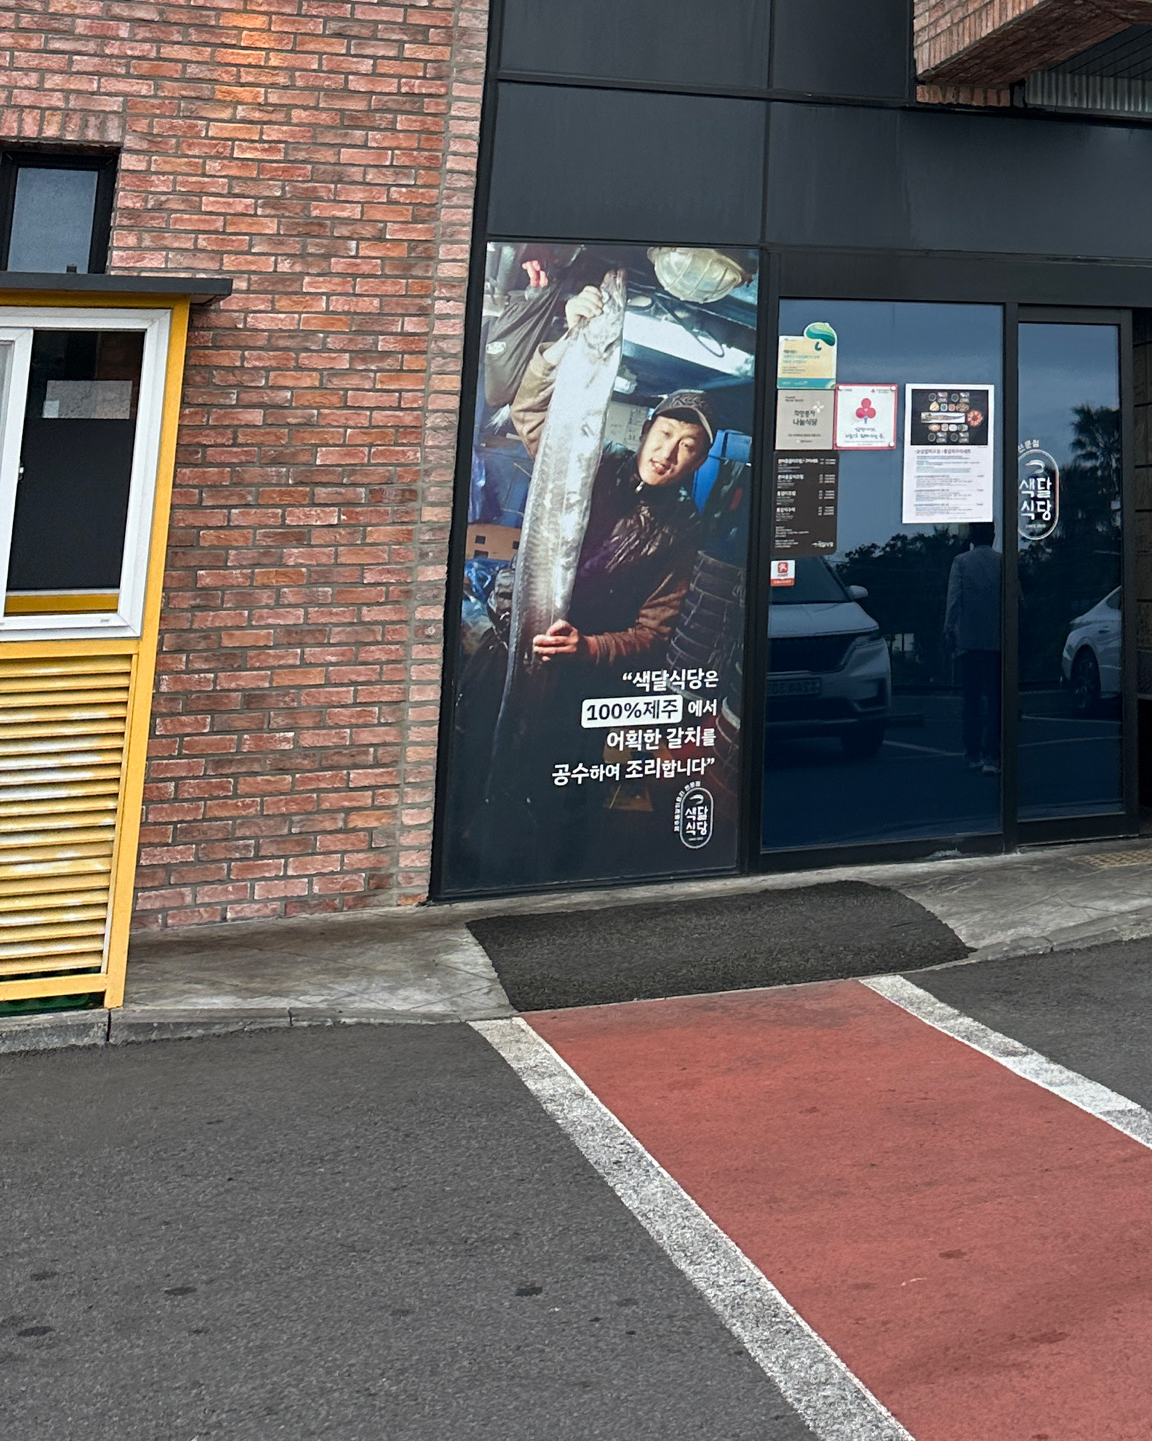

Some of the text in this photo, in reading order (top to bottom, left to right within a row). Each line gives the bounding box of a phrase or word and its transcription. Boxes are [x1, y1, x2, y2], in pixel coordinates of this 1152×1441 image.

[1019, 476, 1053, 499] 색달
[1020, 499, 1052, 521] 식당
[622, 668, 719, 693] “색달식당은
[586, 699, 718, 721] 100%제주 에서
[606, 726, 717, 752] 어획한 갈치를
[552, 757, 715, 787] 공수하여 조리합니다”
[684, 806, 709, 821] 색달
[685, 821, 708, 836] 식당
